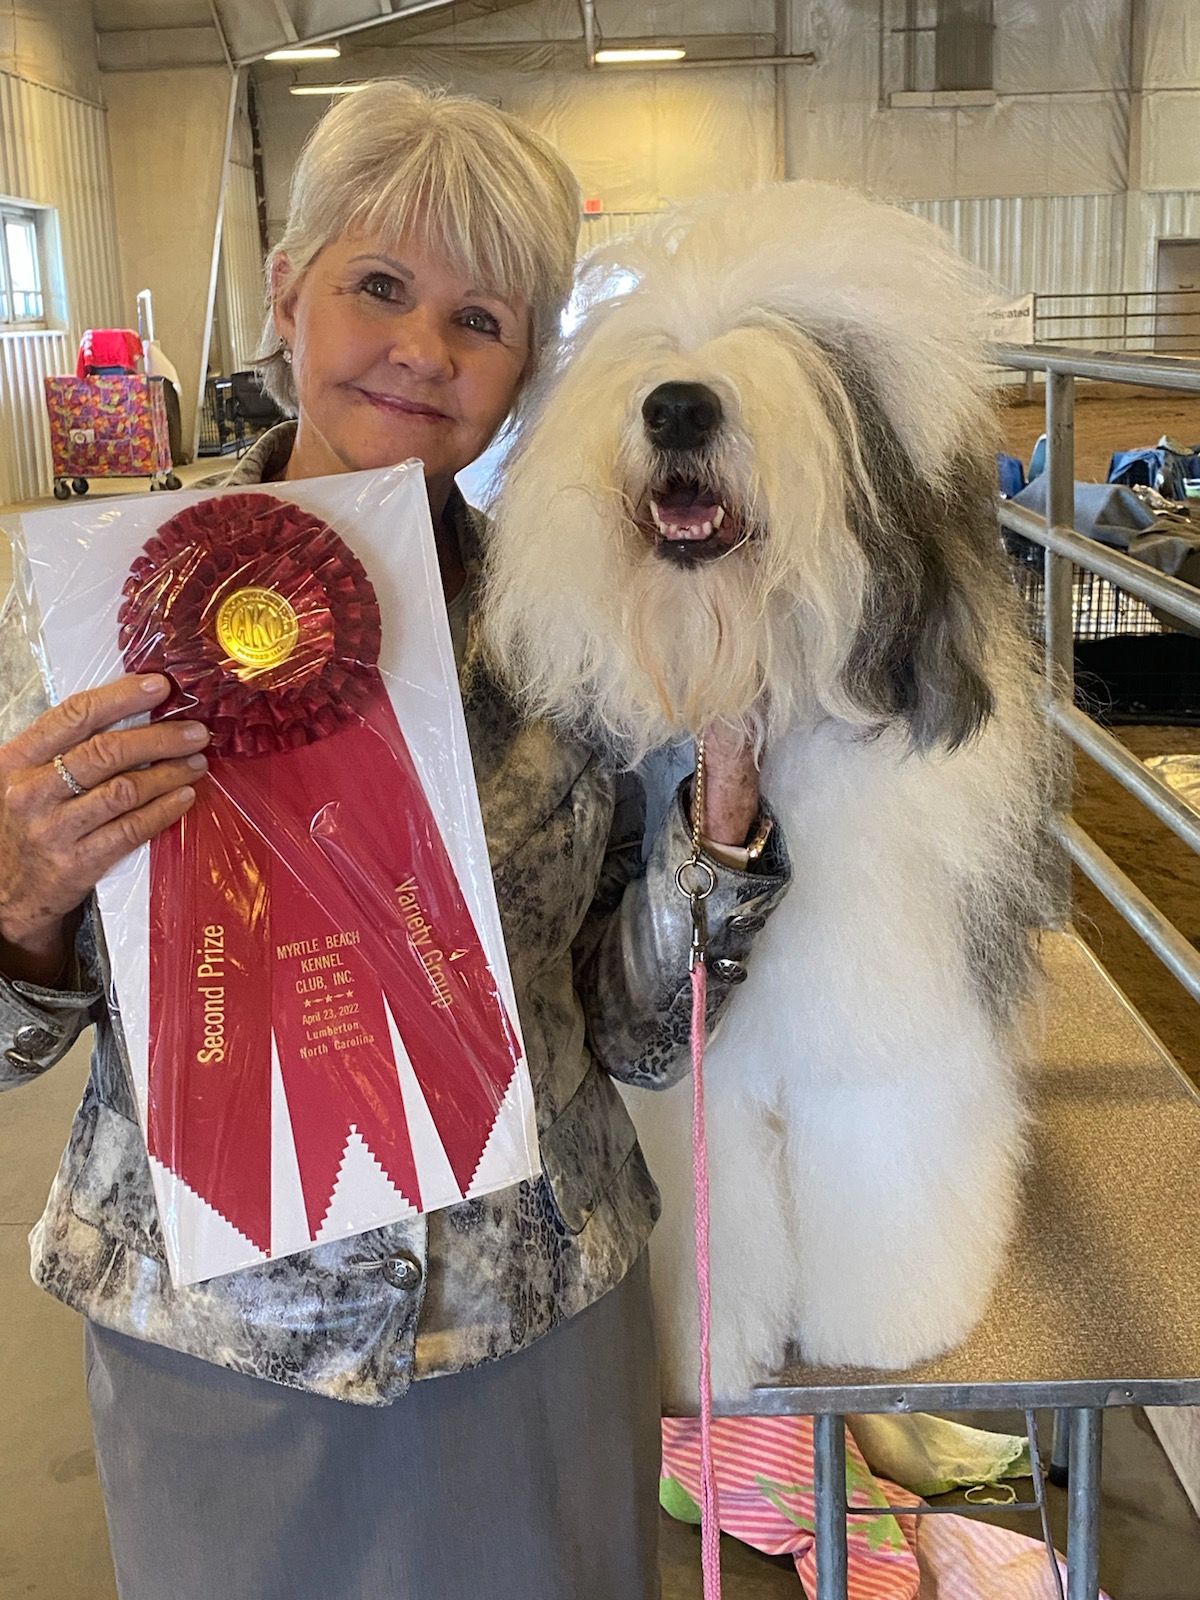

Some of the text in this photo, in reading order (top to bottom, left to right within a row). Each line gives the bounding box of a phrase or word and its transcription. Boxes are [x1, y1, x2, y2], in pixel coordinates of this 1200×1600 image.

[276, 930, 361, 960] MYRTLE BEACH
[394, 876, 454, 1010] Variety Group
[300, 953, 344, 974] KENNEL
[196, 924, 225, 1063] Second Prize
[295, 970, 356, 994] CLUB, INC.
[302, 1003, 360, 1026] April 23, 2022
[306, 1020, 360, 1042] Lumberton
[299, 1033, 375, 1060] North Carolina
